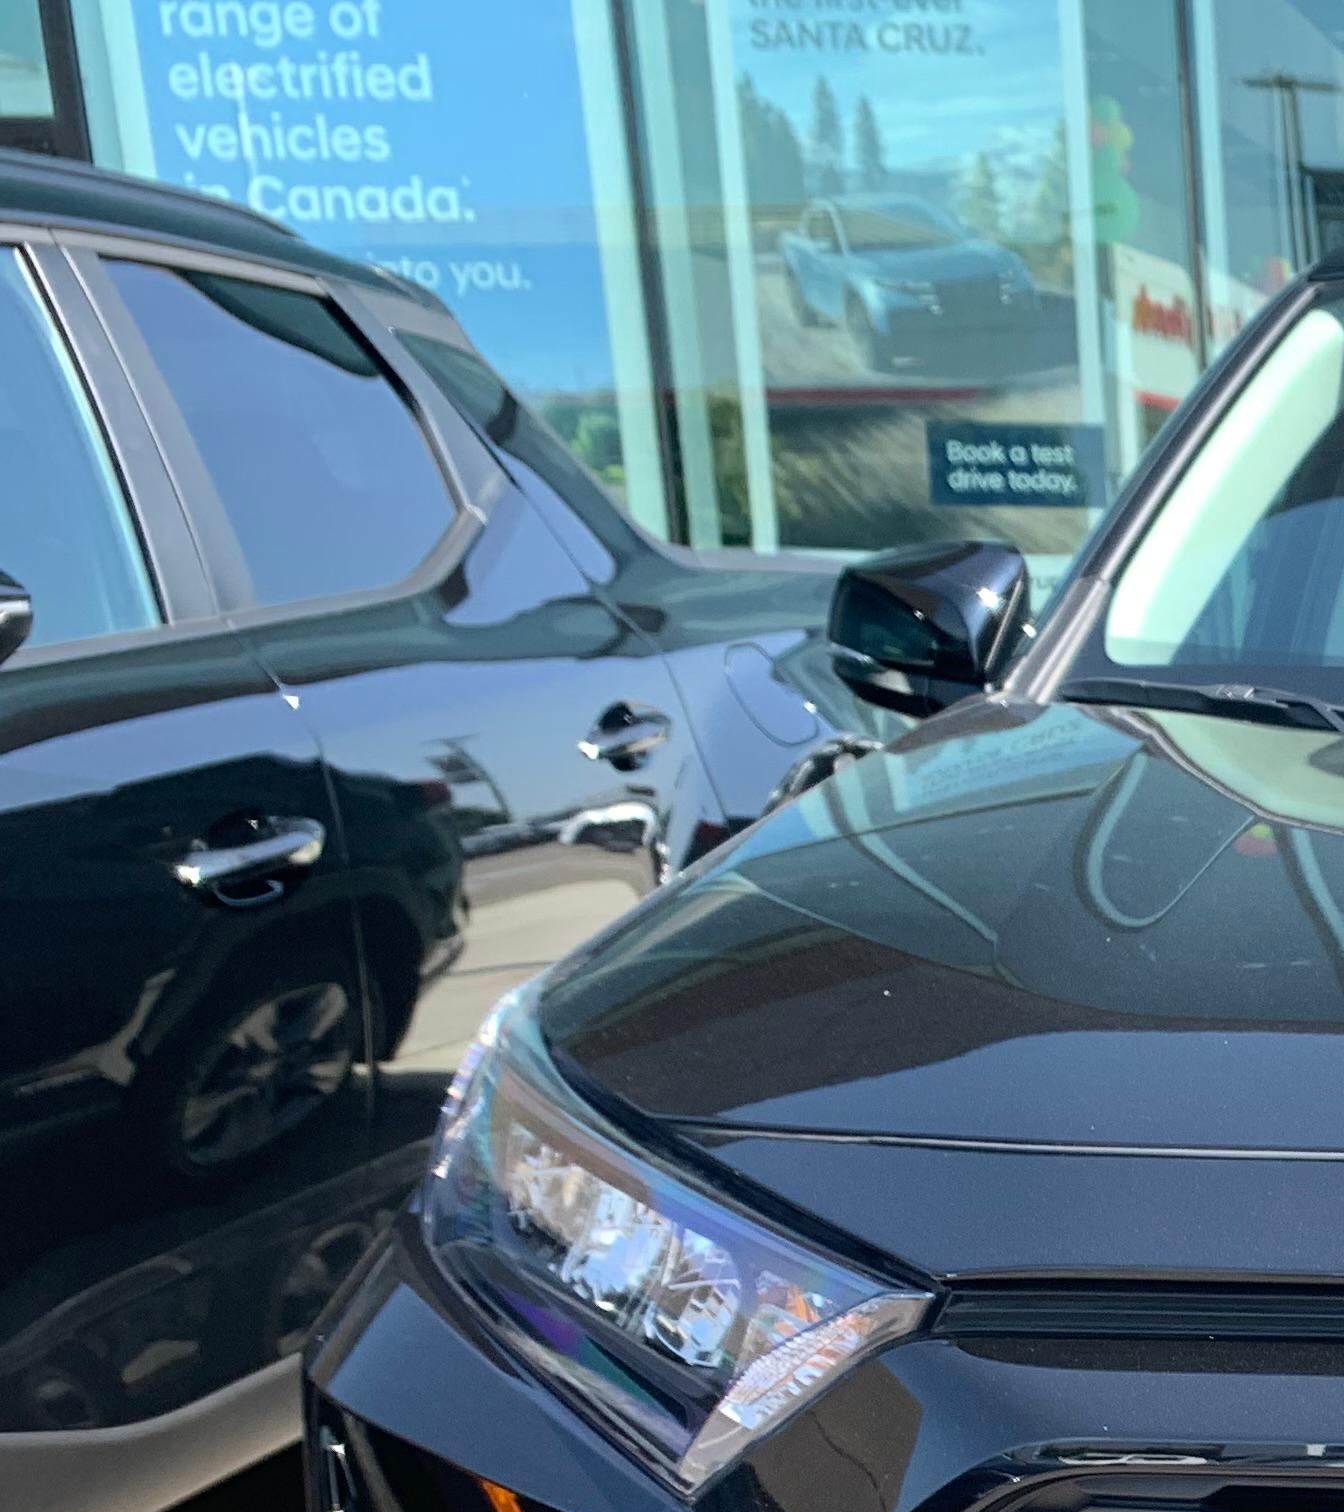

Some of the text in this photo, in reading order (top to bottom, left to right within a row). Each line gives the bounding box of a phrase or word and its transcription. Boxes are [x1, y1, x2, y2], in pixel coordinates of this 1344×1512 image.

[158, 0, 382, 47] range of
[750, 18, 985, 56] SANTA CRUZ.
[168, 51, 433, 101] electrified
[174, 112, 391, 162] vehicles
[448, 260, 533, 297] you.
[946, 439, 1073, 466] Book a test
[947, 468, 1077, 495] drive today.
